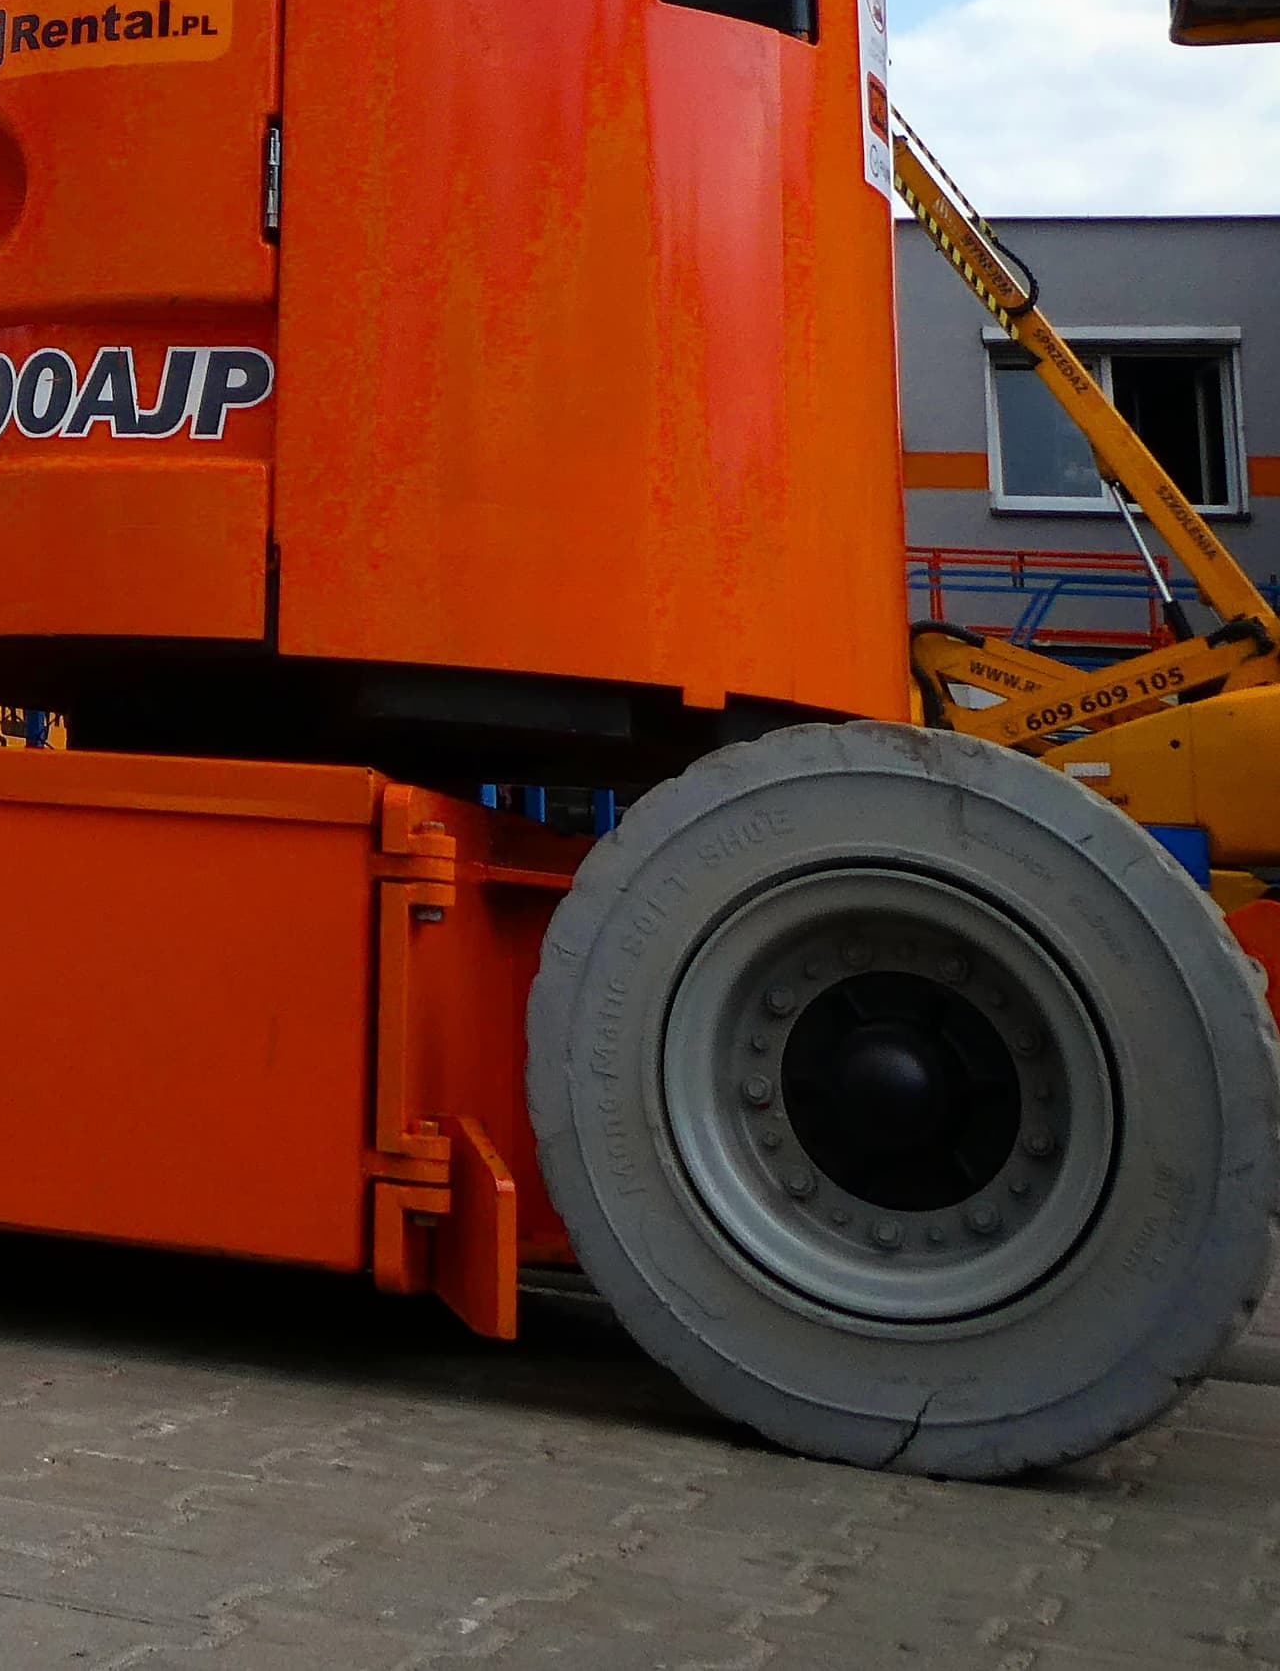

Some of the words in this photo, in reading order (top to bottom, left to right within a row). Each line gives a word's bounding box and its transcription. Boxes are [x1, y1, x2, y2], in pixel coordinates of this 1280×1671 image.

[1026, 702, 1073, 731] 609
[1080, 684, 1129, 713] 609
[1135, 666, 1185, 695] 105
